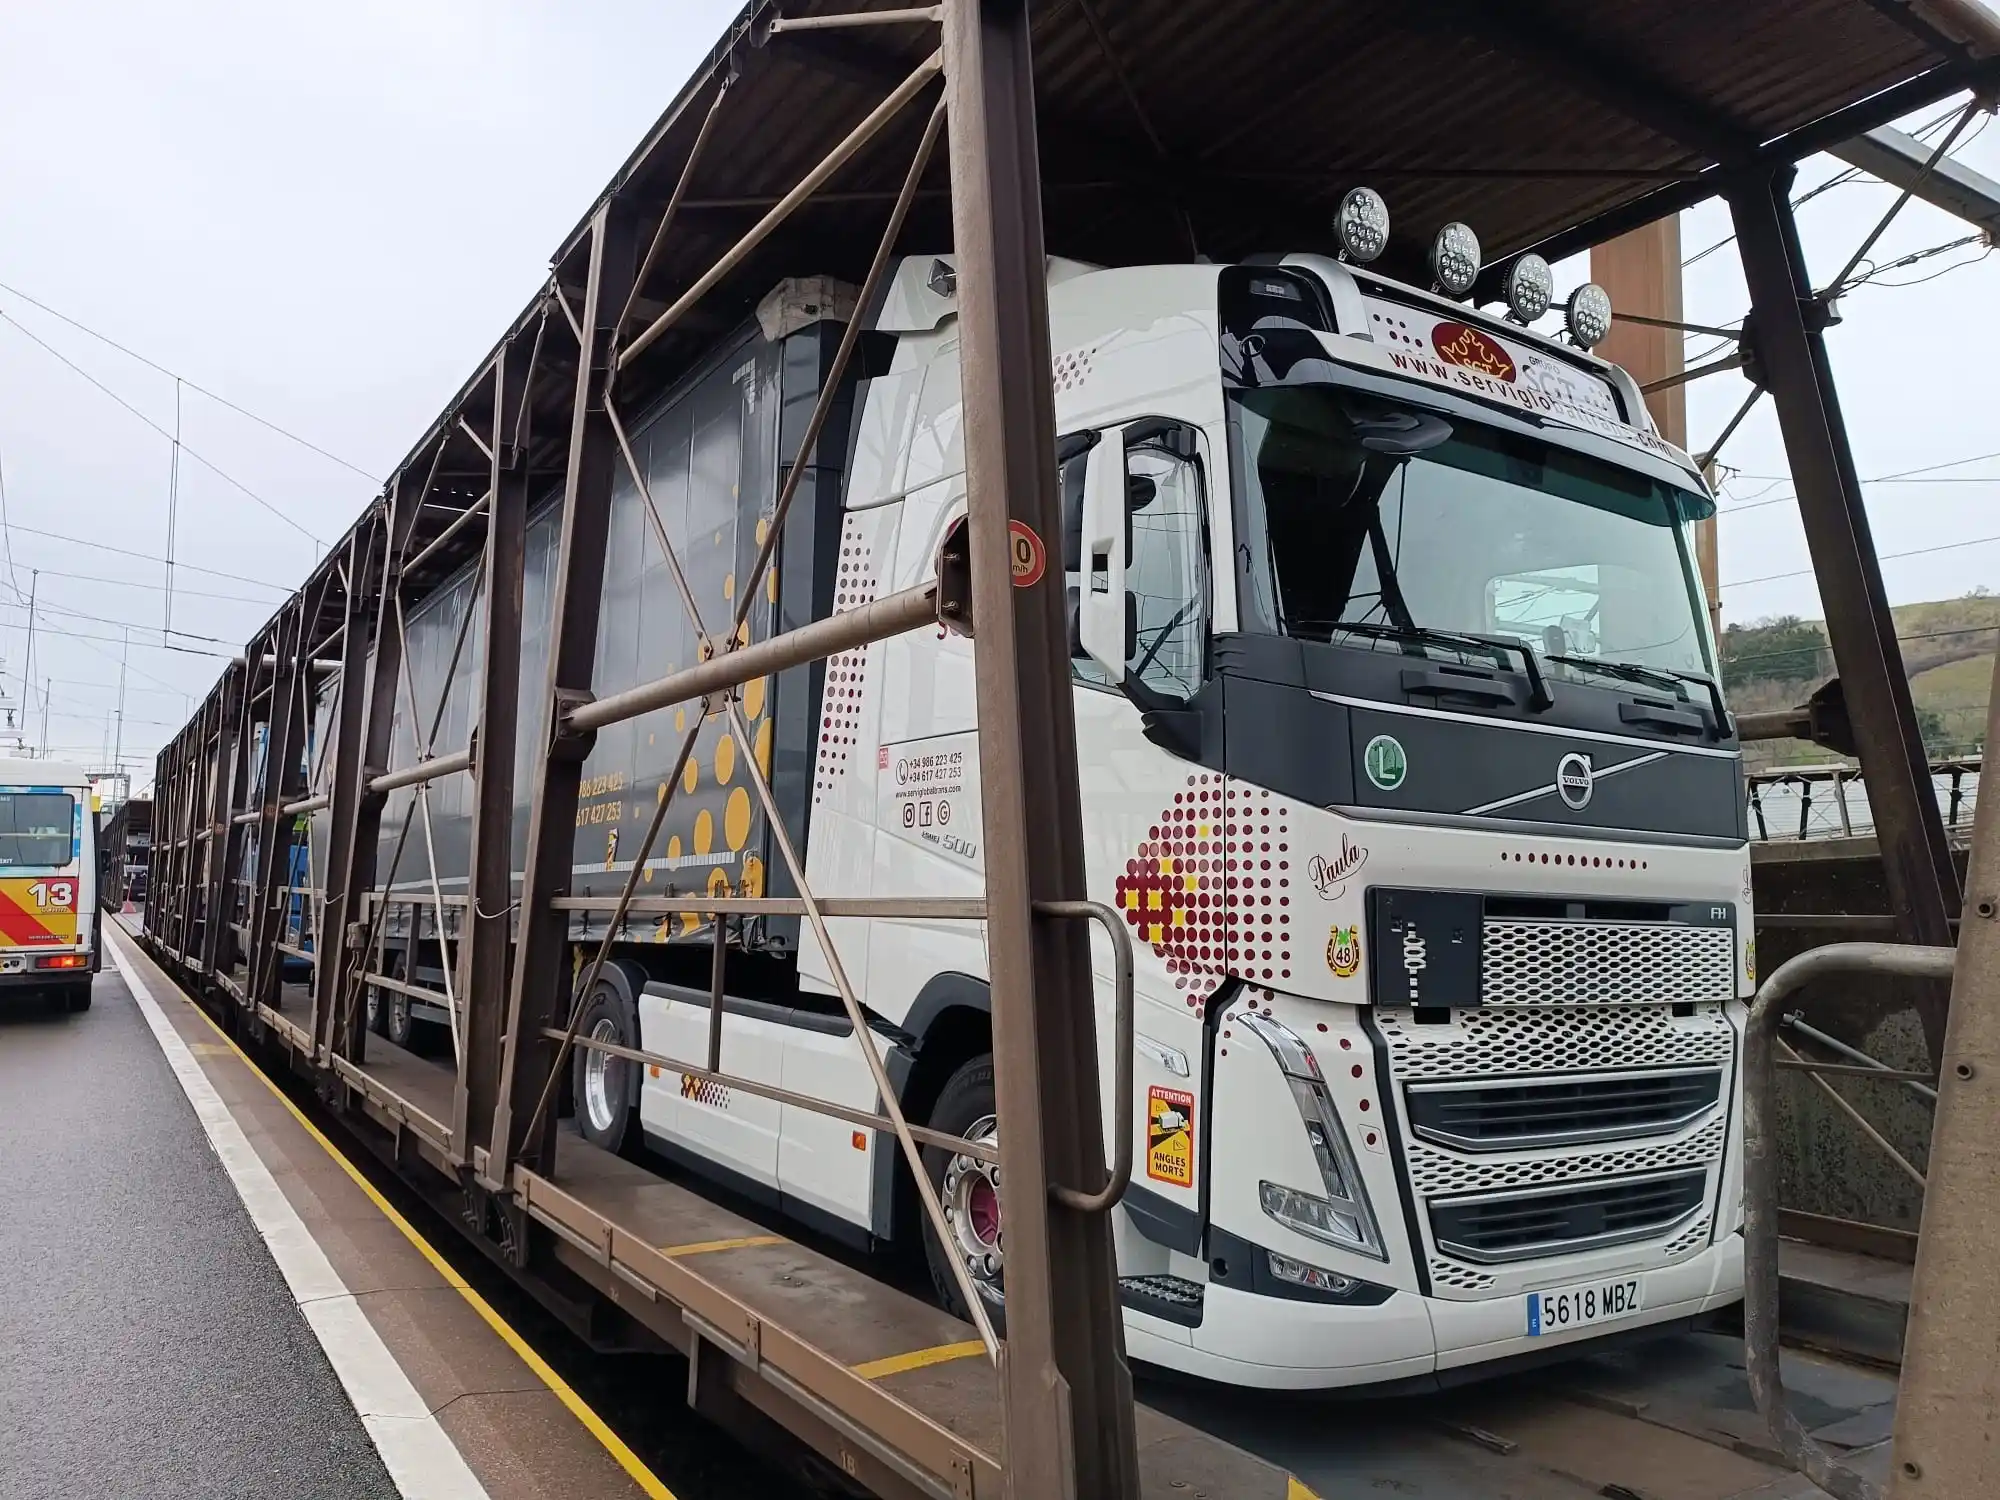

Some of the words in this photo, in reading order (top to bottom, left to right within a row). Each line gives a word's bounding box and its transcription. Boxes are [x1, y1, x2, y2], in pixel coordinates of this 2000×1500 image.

[1016, 538, 1031, 564] 0
[1012, 564, 1028, 574] m/h
[909, 759, 920, 769] +34
[922, 756, 934, 768] 986
[935, 754, 948, 766] 223
[949, 752, 962, 763] 425
[909, 772, 920, 783] +34
[922, 770, 934, 781] 617
[935, 768, 948, 780] 427
[949, 766, 962, 779] 253
[1562, 776, 1590, 786] VOLVO
[576, 807, 590, 827] 617
[591, 803, 606, 824] 427
[607, 800, 621, 821] 253
[1308, 833, 1368, 900] Paula
[28, 882, 73, 907] 13
[1710, 907, 1727, 920] FH
[1336, 947, 1351, 963] 48
[1151, 1088, 1192, 1104] ATTENTION
[1154, 1151, 1186, 1167] ANGLES
[1155, 1163, 1185, 1178] MORTS
[1544, 1290, 1596, 1326] 5618
[1602, 1281, 1637, 1315] MBZ
